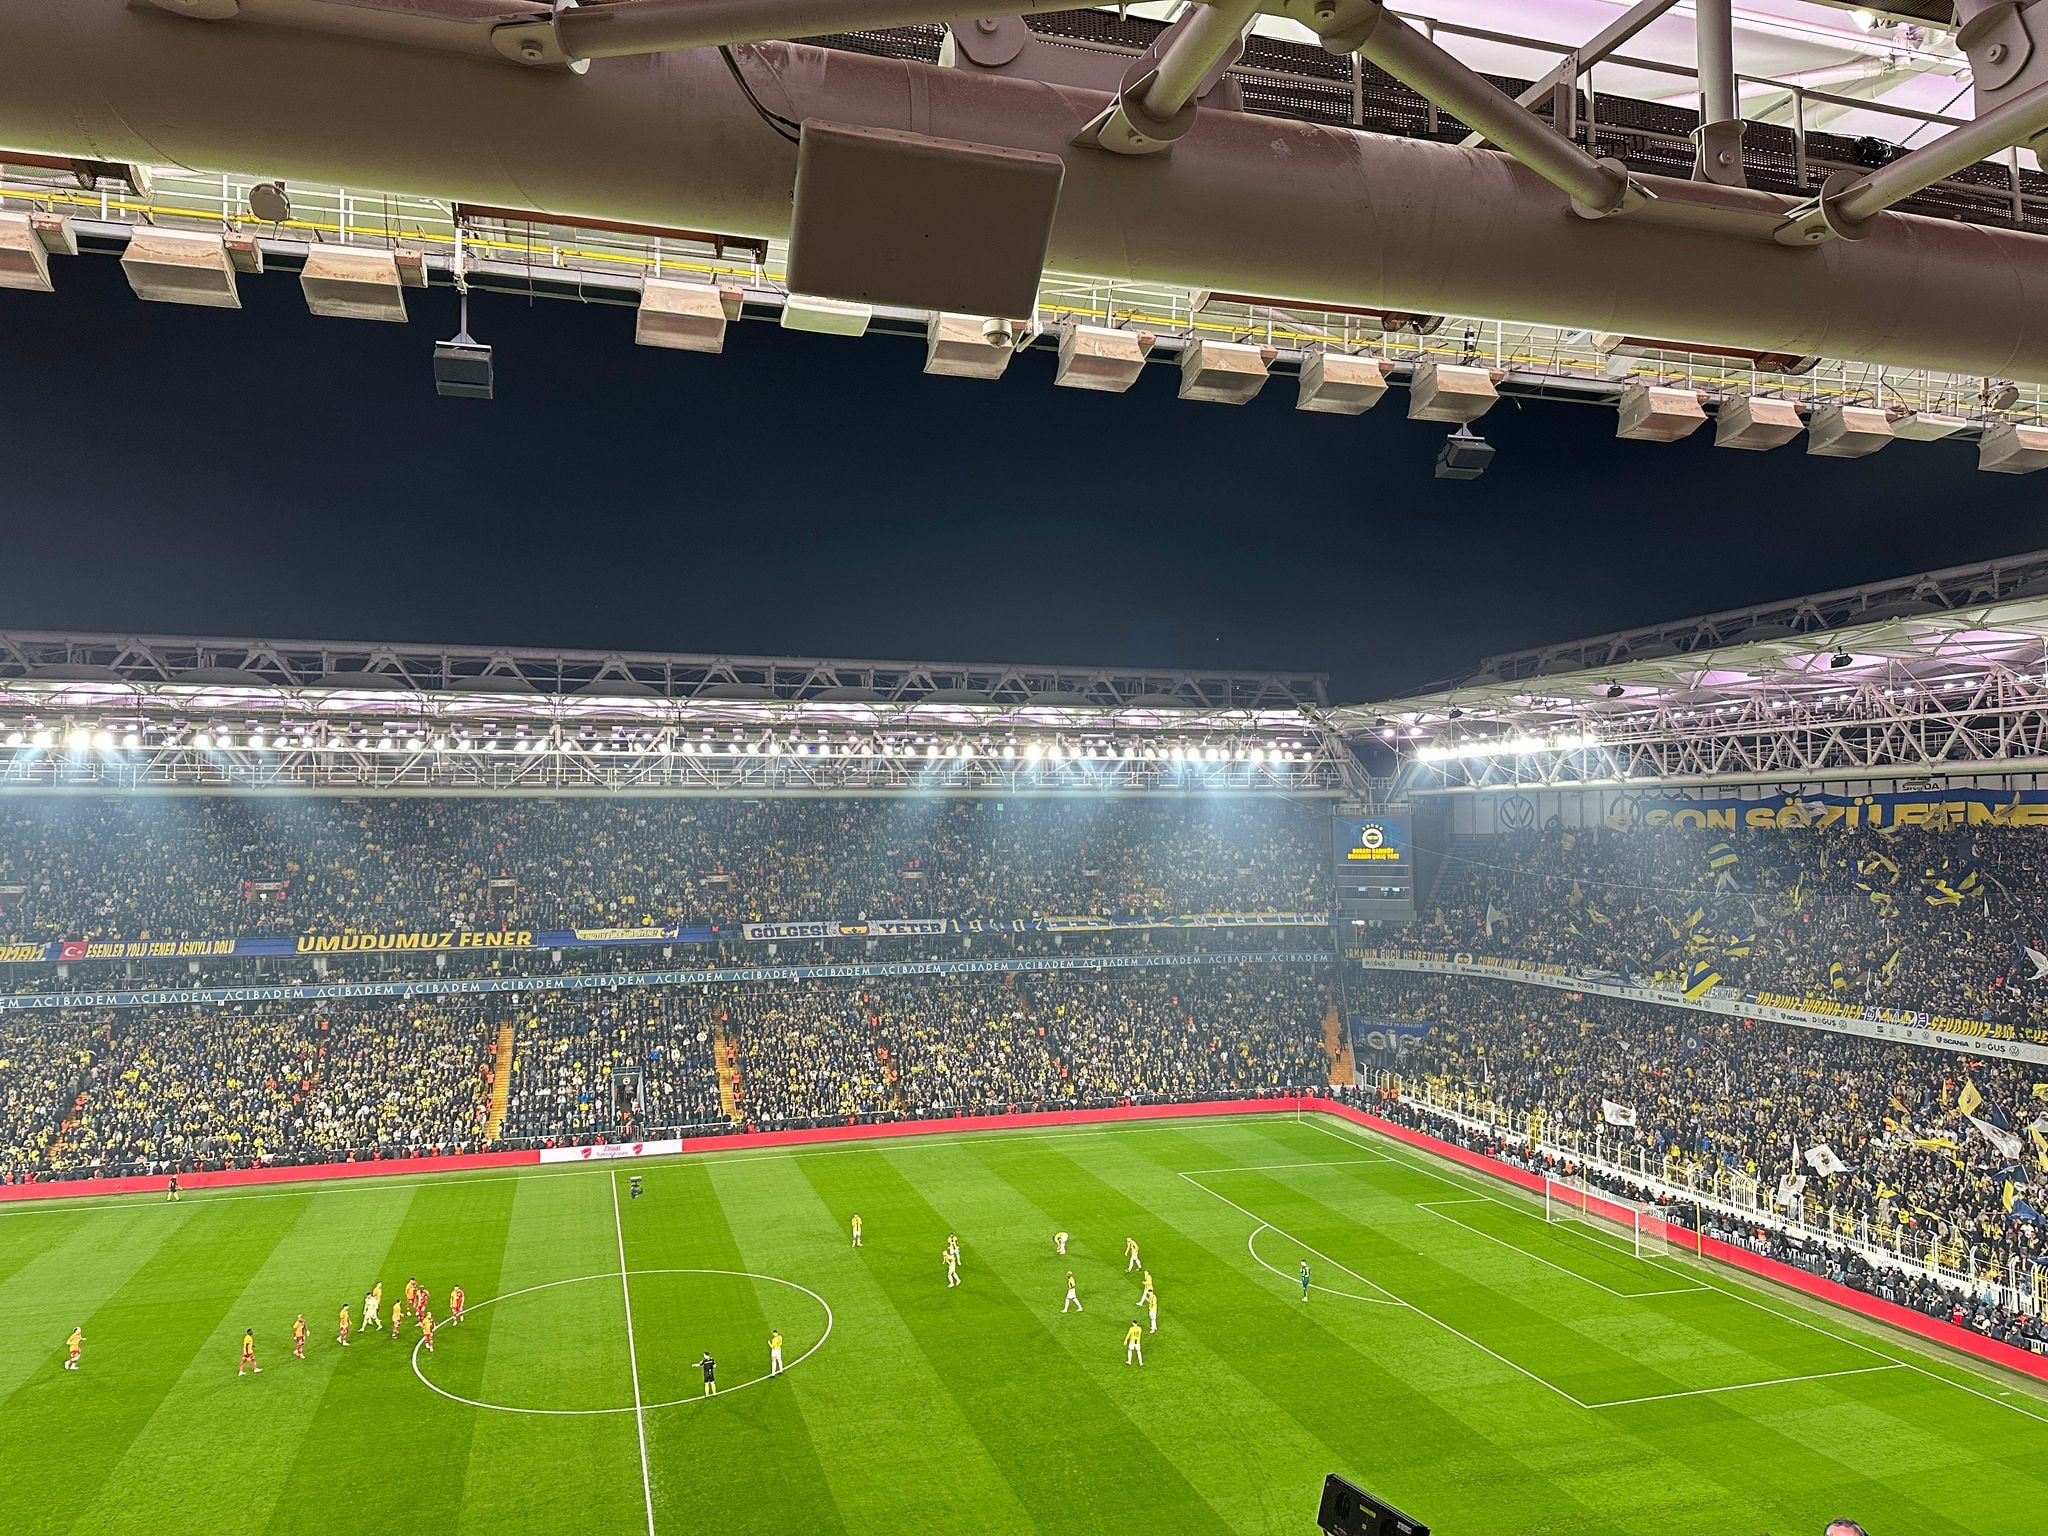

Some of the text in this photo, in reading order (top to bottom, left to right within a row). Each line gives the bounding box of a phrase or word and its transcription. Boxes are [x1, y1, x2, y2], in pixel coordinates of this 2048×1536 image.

[751, 921, 941, 938] GÖLGESİ YETER
[85, 943, 125, 958] ESENLER
[126, 942, 148, 957] YOLU
[147, 942, 176, 957] FENER
[212, 940, 236, 955] DOLU
[297, 931, 532, 952] UMUDUMUZ FENER
